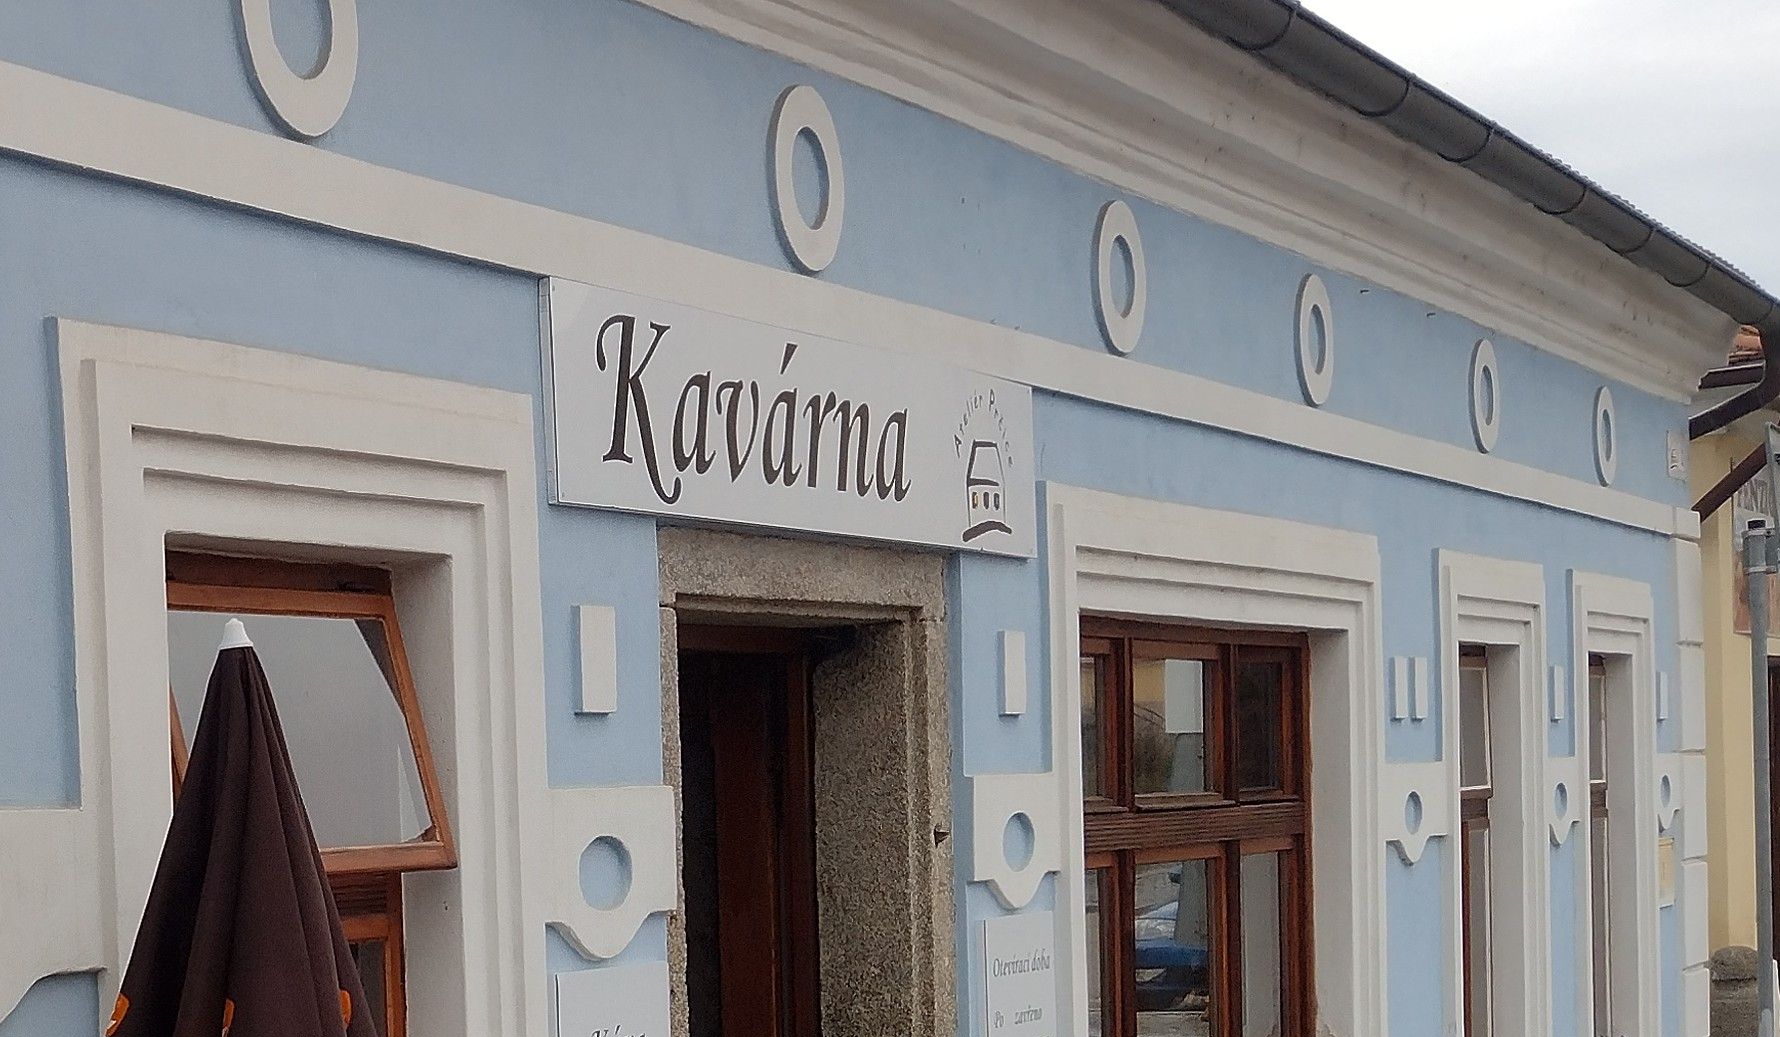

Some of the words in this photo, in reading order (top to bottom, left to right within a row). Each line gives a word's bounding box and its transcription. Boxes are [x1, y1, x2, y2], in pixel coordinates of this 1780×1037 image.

[597, 314, 912, 505] Kavárna
[1031, 948, 1050, 971] doba
[994, 1010, 1005, 1029] Po
